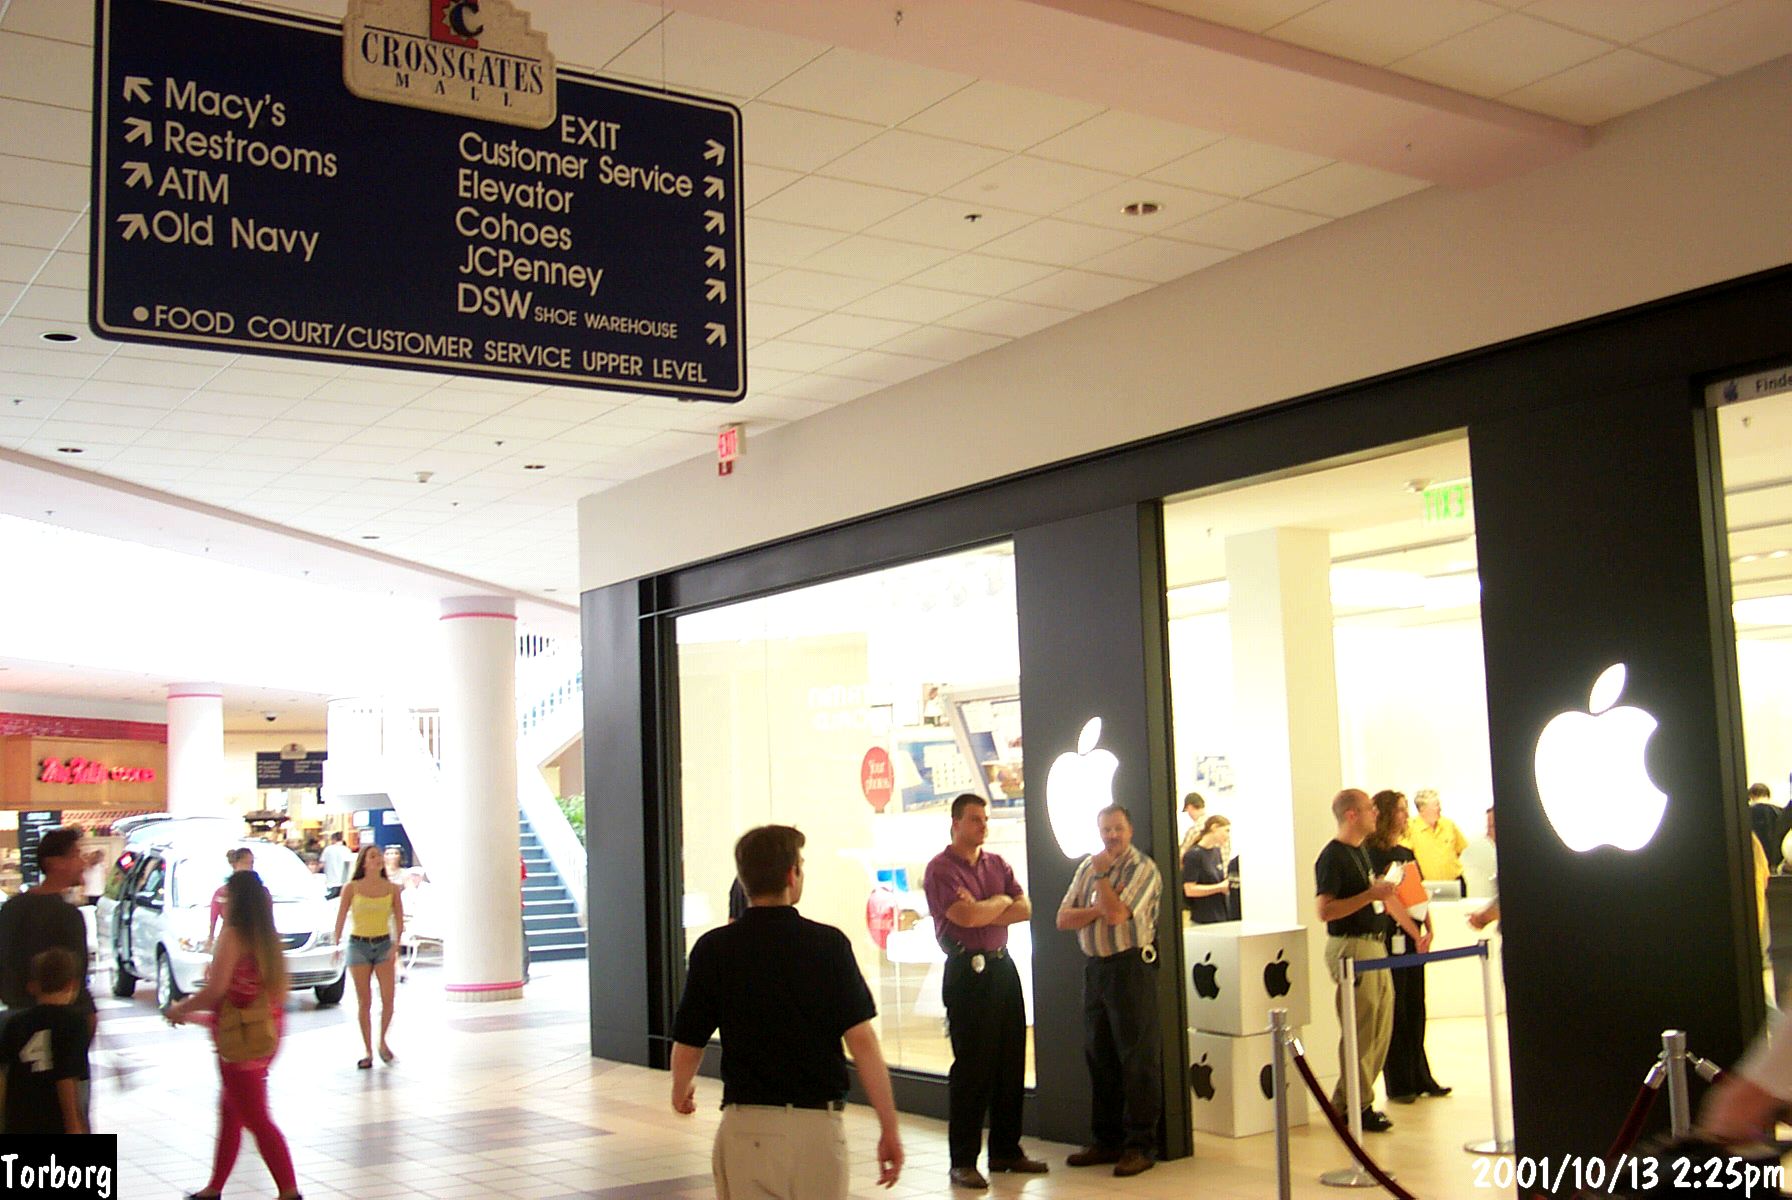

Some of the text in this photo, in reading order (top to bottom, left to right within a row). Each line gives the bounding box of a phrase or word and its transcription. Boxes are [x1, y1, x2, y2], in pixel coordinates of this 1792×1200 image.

[361, 31, 544, 95] CROSSGATES
[165, 77, 286, 128] Macy's
[396, 72, 512, 107] MALL
[164, 120, 338, 178] Restrooms
[561, 114, 621, 151] EXIT
[158, 166, 229, 205] ATM
[459, 131, 693, 198] Customer Service
[458, 168, 574, 214] Elevator
[152, 210, 319, 262] Old Navy
[455, 206, 572, 251] Cohoes
[459, 245, 603, 297] JCPenney
[457, 282, 679, 340] DSW SHOE WAREHOUSE
[155, 304, 235, 334] FOOD
[484, 340, 571, 370] SERVICE
[583, 350, 643, 377] UPPER
[653, 357, 708, 384] LEVEL
[719, 429, 737, 458] EXIT
[18, 1028, 54, 1073] 4
